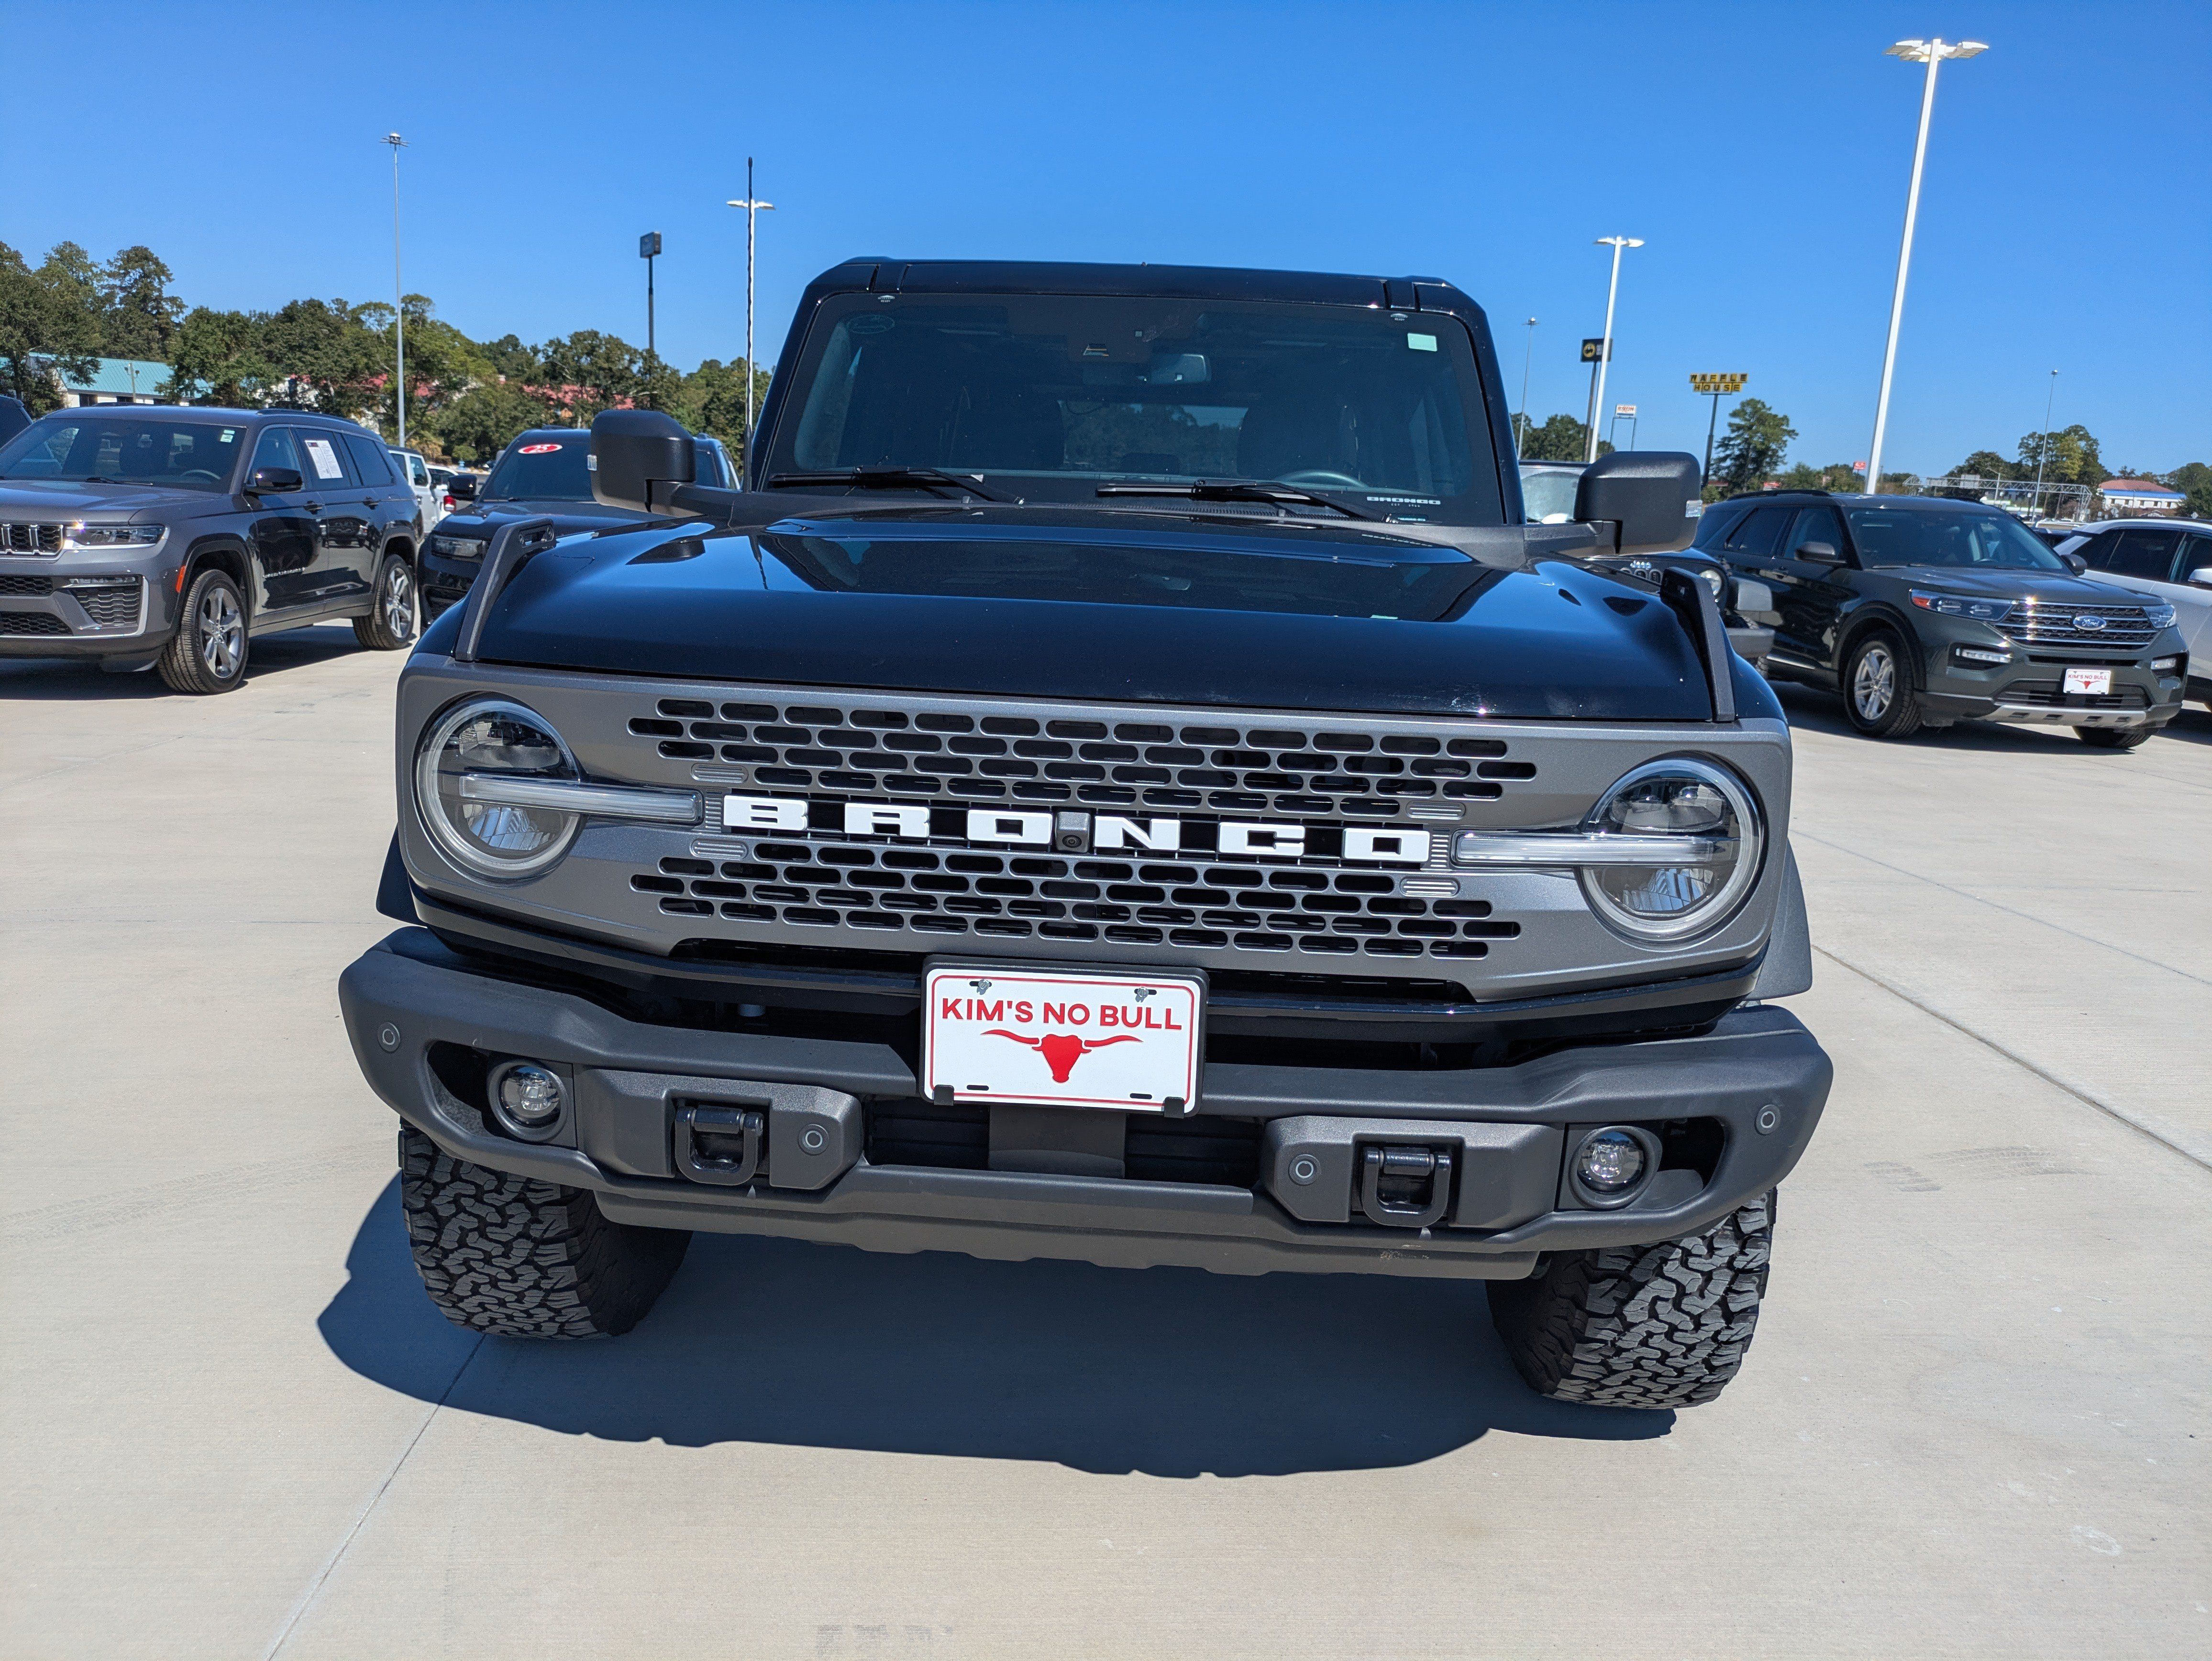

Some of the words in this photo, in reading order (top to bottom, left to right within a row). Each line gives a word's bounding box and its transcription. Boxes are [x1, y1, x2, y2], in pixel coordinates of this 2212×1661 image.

[1690, 374, 1747, 382] WAFFLE
[1367, 496, 1441, 505] BRONCO
[723, 795, 1430, 863] BRONCO
[942, 997, 1034, 1023] KIM'S
[1043, 1002, 1091, 1026] NO
[1100, 1005, 1183, 1031] BULL
